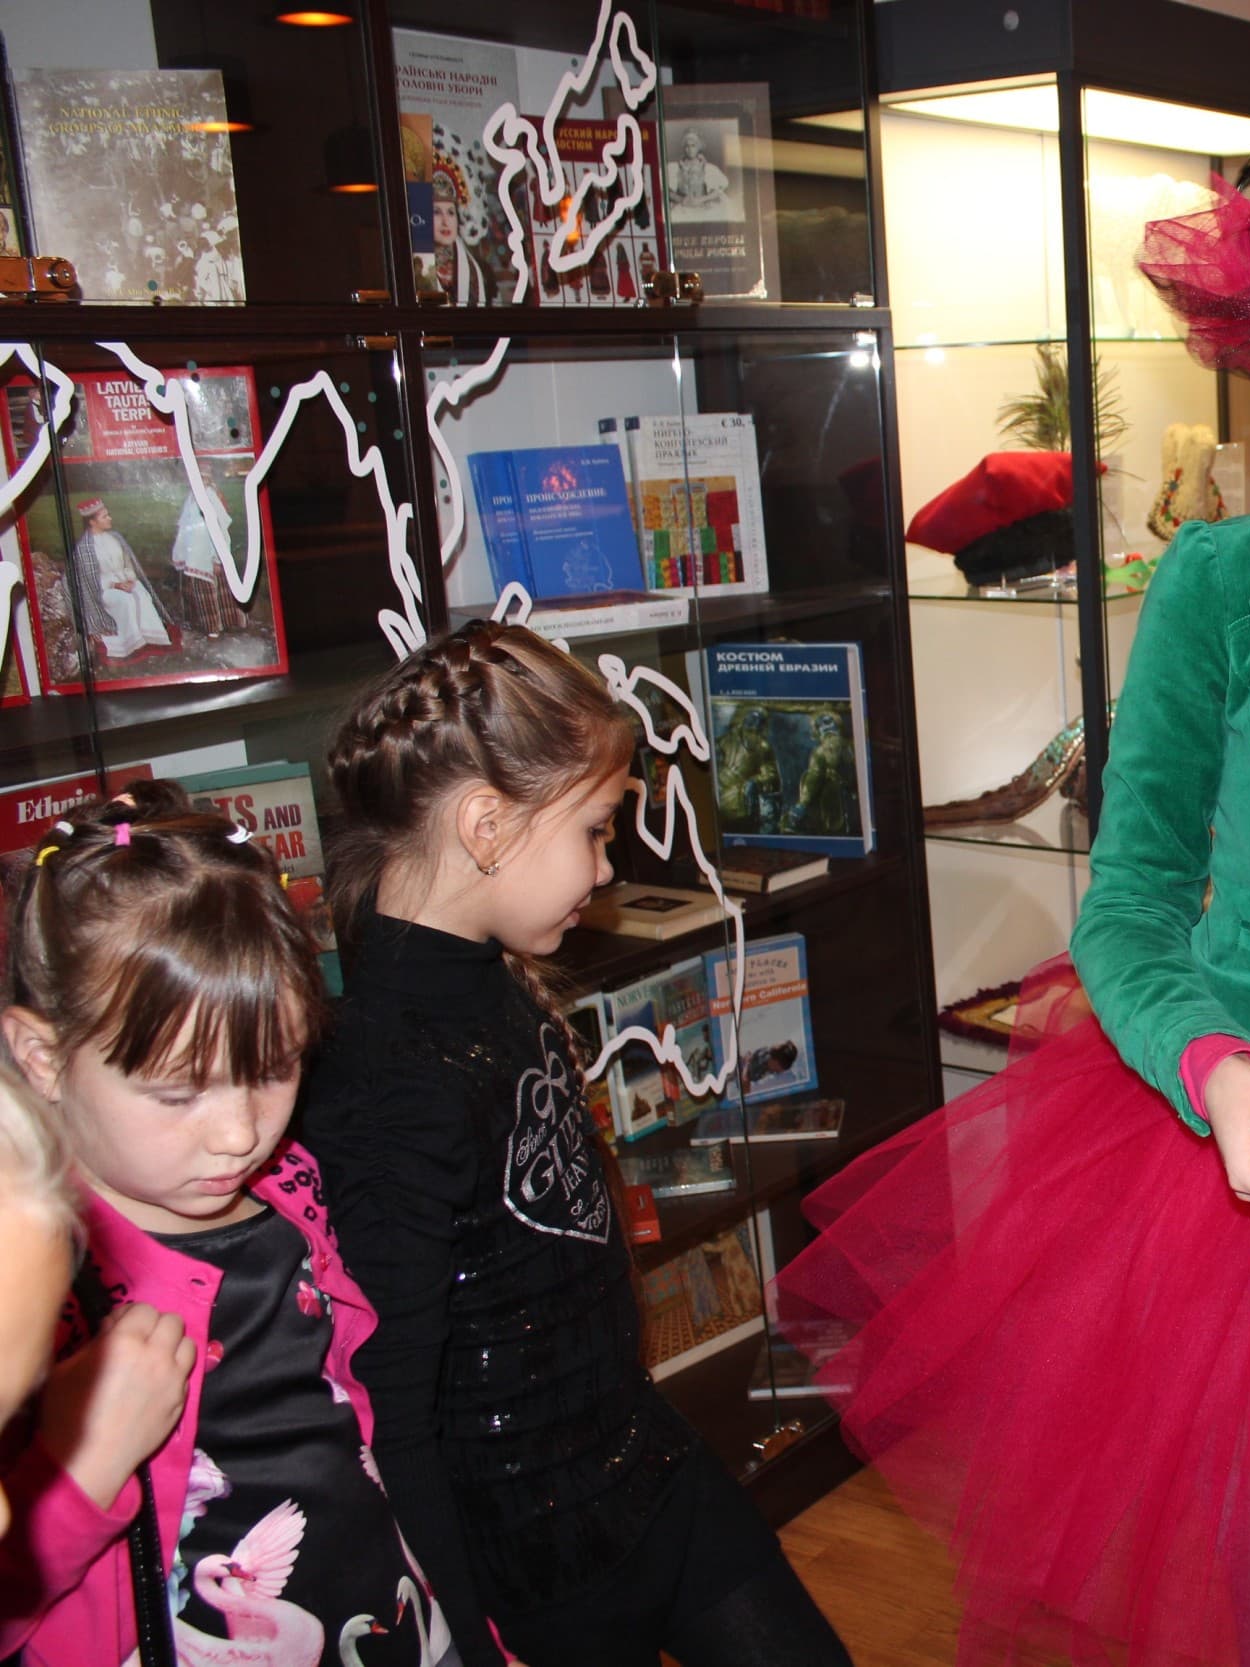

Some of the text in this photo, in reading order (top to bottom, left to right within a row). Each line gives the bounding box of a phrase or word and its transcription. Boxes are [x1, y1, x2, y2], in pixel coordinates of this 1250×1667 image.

[394, 64, 447, 80] РАЇНСЬКІ
[558, 127, 594, 139] УССКИЙ
[96, 381, 143, 395] LATVIE
[716, 651, 784, 662] КОСТЮМ
[718, 663, 838, 673] ДРЕВНЕЙ ЕВРАЗИИ
[263, 804, 302, 831] AND
[712, 993, 758, 1010] Norrn
